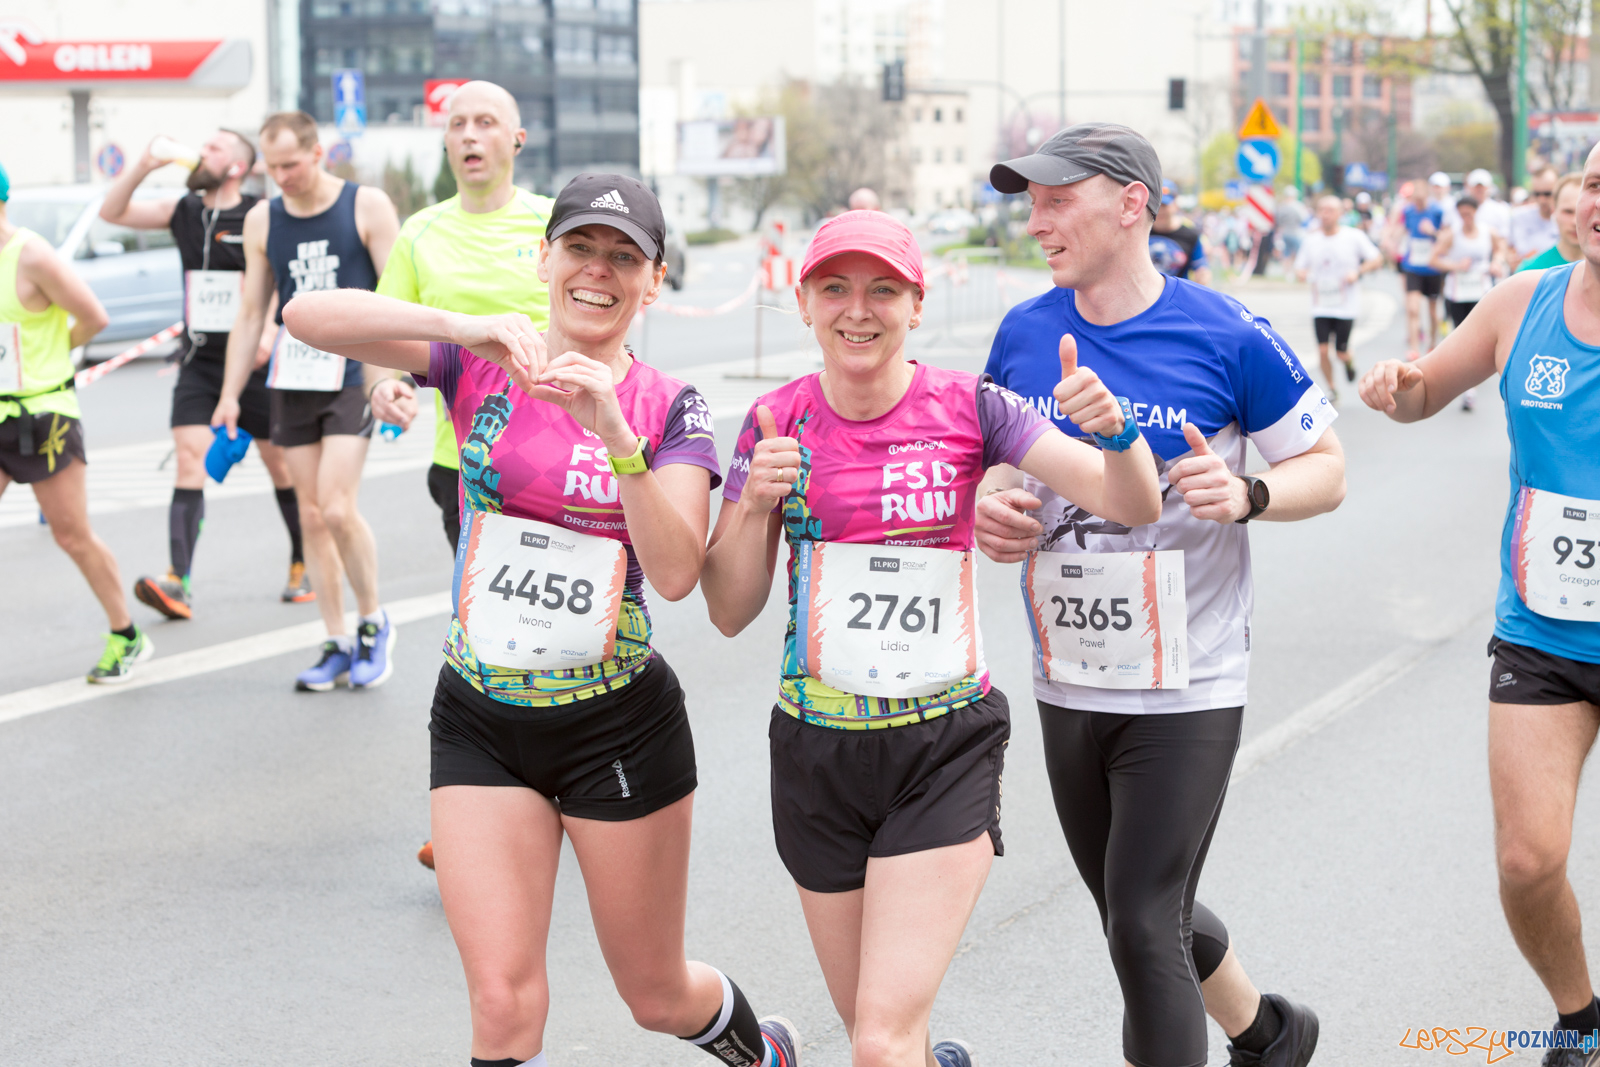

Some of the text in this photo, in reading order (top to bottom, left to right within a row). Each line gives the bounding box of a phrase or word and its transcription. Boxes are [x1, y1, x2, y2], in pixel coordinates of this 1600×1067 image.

[54, 44, 152, 72] ORLEN
[590, 200, 630, 214] adidas
[297, 240, 329, 260] EAT
[288, 254, 340, 278] SLEEP
[1254, 322, 1304, 384] yanosik.pl
[683, 396, 708, 412] FS
[1129, 402, 1187, 430] EAM
[1521, 399, 1562, 410] KROTOSZYN
[683, 412, 714, 432] RU
[570, 444, 612, 472] FS
[563, 470, 622, 504] RU
[882, 460, 958, 490] FSD
[881, 490, 956, 522] RUN
[1553, 536, 1600, 569] 93
[488, 564, 594, 615] 4458
[518, 614, 552, 629] Iwona
[847, 592, 941, 634] 2761
[1050, 595, 1132, 631] 2365
[880, 640, 909, 651] Lidia
[1080, 638, 1105, 648] Paweł
[616, 768, 630, 798] Reebok
